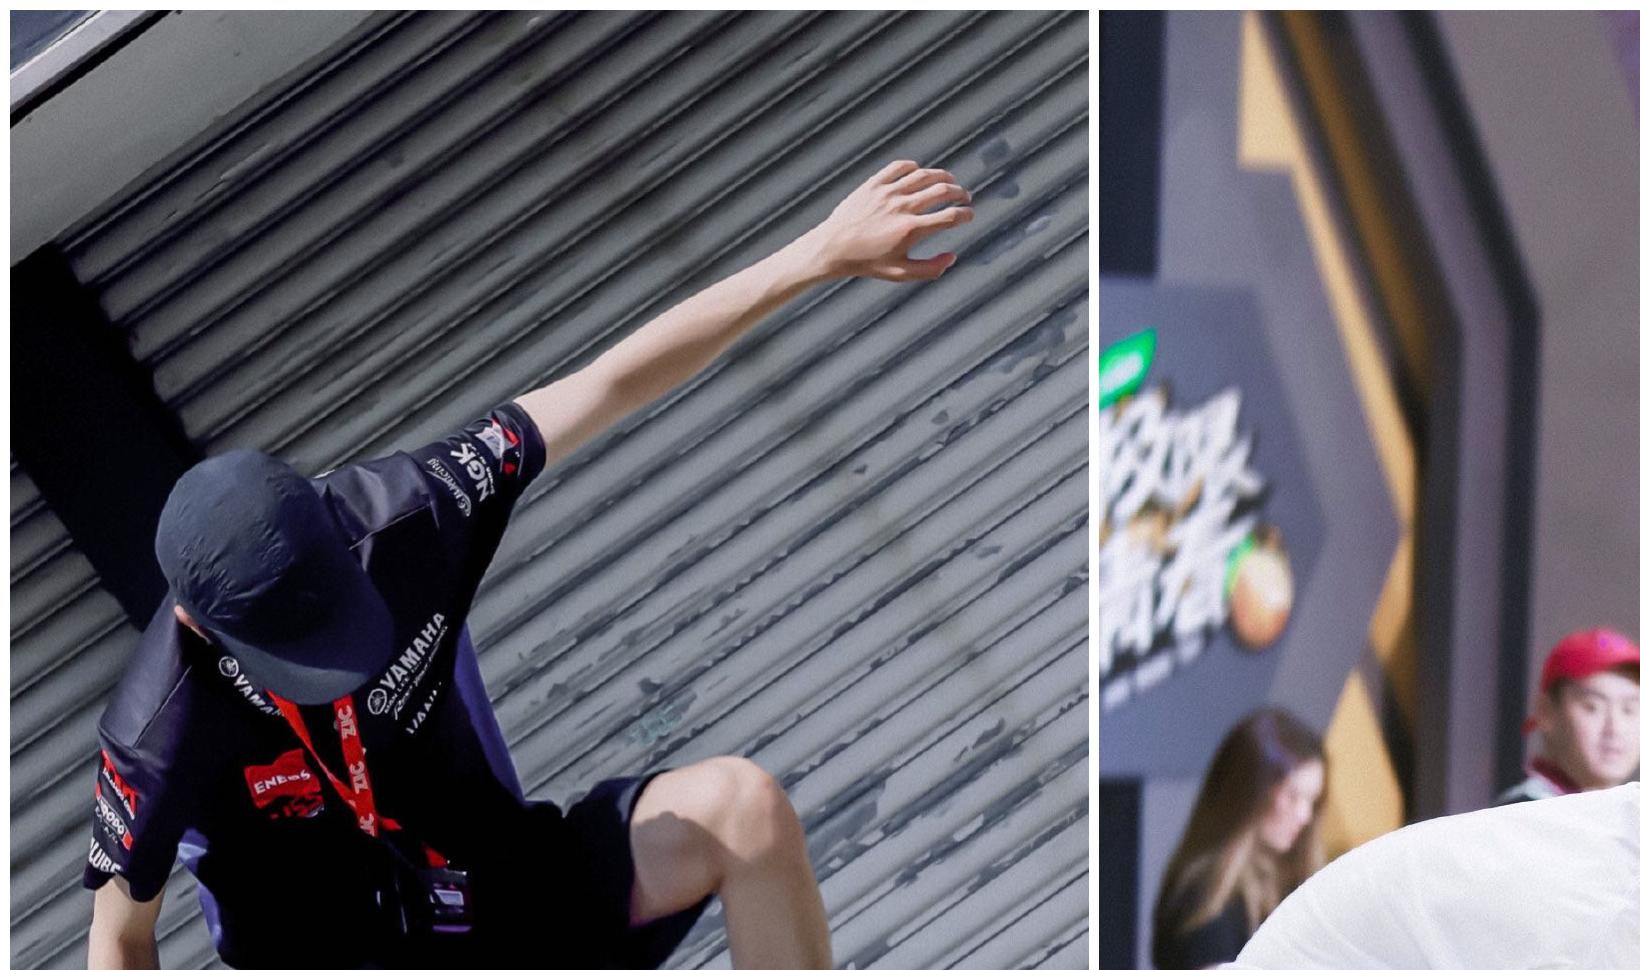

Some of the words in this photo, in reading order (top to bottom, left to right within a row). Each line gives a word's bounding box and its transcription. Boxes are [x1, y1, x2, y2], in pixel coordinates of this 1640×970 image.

[450, 443, 489, 502] NGK
[380, 613, 445, 689] YAMAHA
[338, 705, 357, 739] ZIC
[350, 761, 369, 794] ZIC
